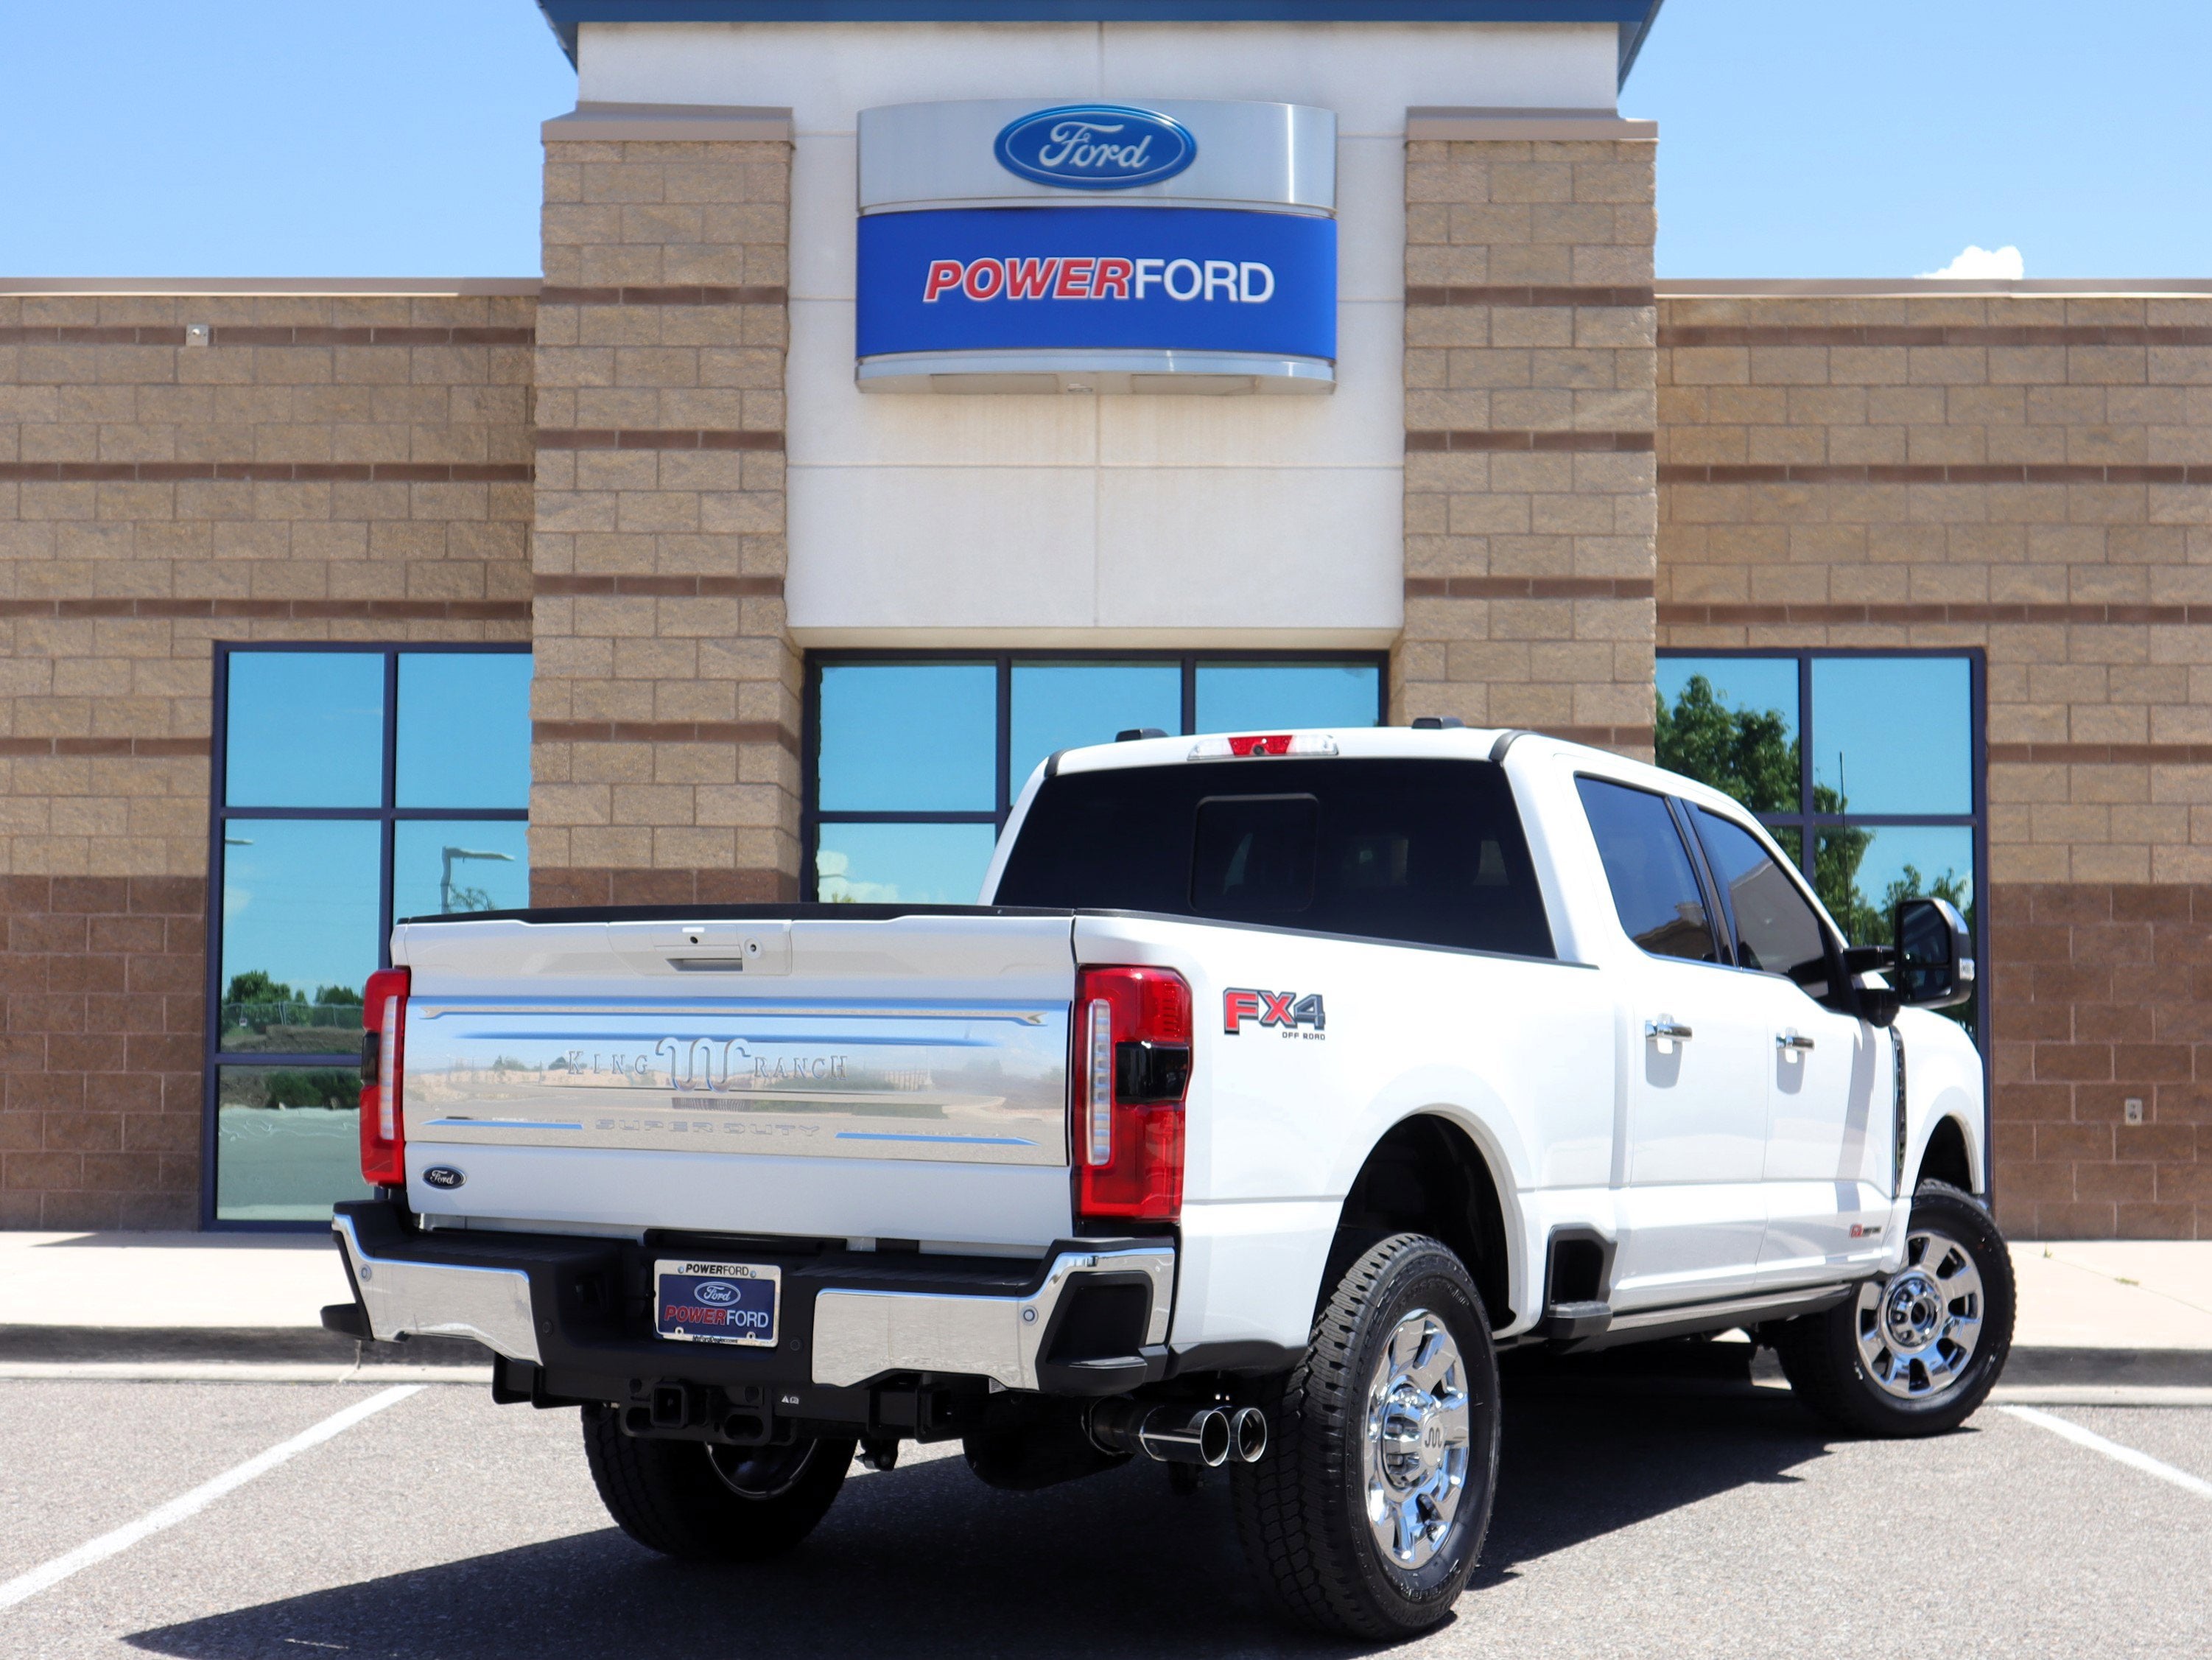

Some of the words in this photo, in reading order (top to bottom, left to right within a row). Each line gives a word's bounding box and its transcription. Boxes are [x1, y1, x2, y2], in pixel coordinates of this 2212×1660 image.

[1039, 120, 1153, 169] Ford
[922, 257, 1275, 304] POWERFORD
[1223, 987, 1326, 1035] FX4
[1282, 1031, 1300, 1039] OFF
[1302, 1032, 1326, 1040] ROAD
[567, 1051, 648, 1075] KING
[754, 1055, 849, 1081] RANCH
[595, 1118, 714, 1133] SUPER
[723, 1122, 821, 1136] DUTY
[430, 1169, 454, 1185] Ford
[686, 1263, 749, 1277] POWERFORD
[703, 1286, 731, 1302] Ford
[664, 1305, 769, 1328] POWERFORD
